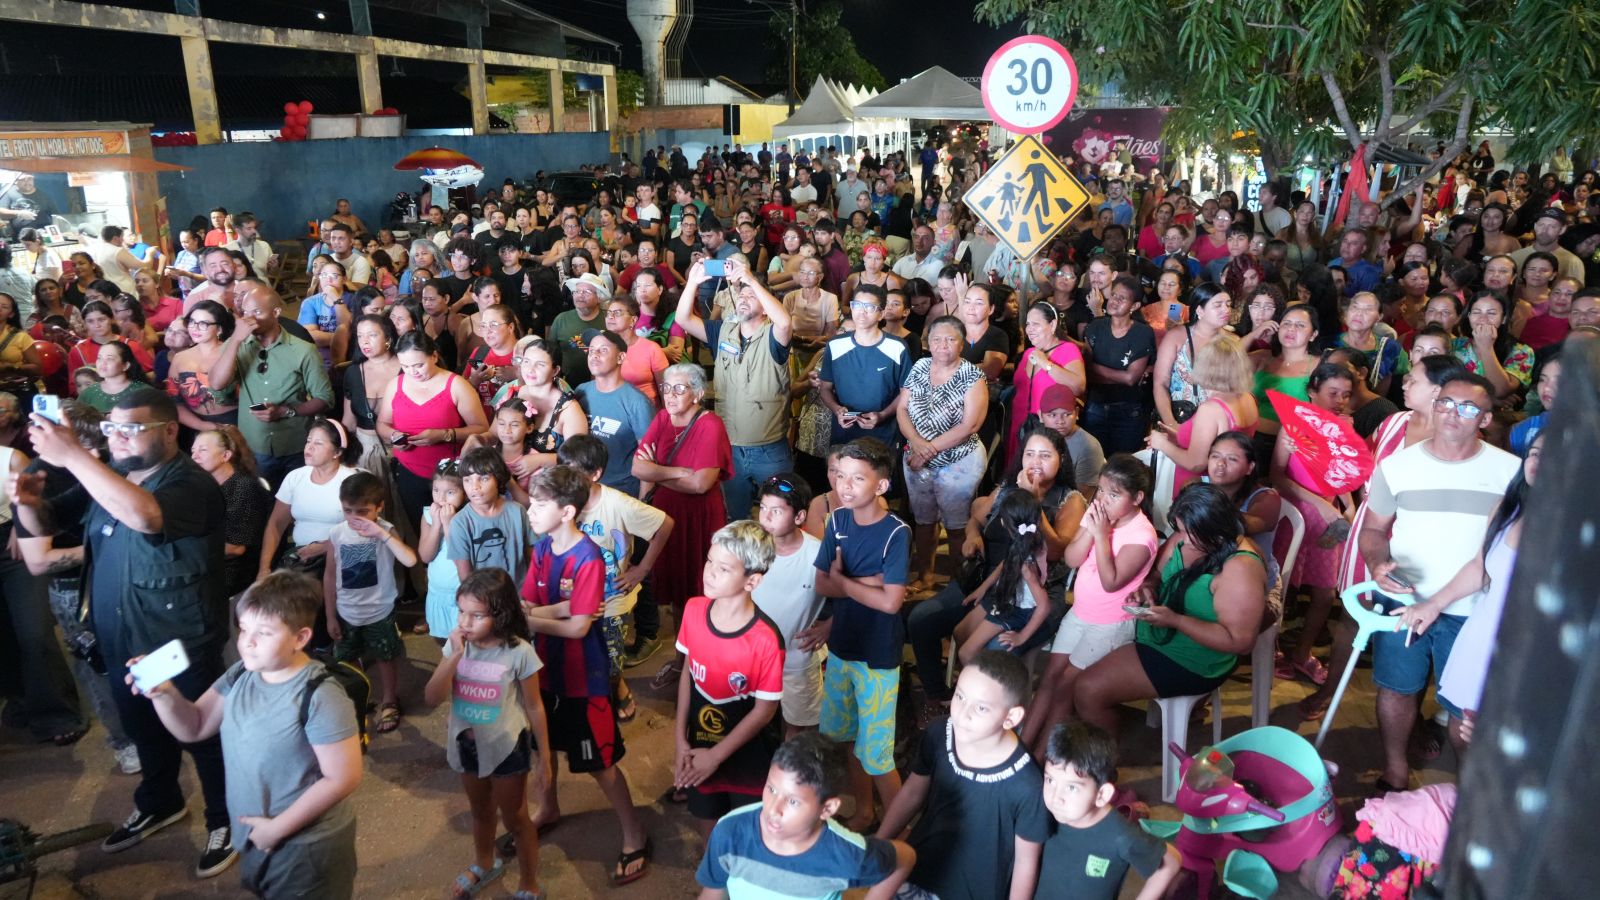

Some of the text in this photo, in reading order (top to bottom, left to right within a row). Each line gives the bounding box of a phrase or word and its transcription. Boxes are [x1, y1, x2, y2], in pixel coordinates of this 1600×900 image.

[1006, 57, 1053, 96] 30
[1016, 99, 1047, 112] km/h
[14, 139, 35, 157] FRITO
[36, 138, 47, 156] NA
[47, 138, 68, 155] HORA
[75, 138, 90, 154] HOT
[89, 137, 104, 154] DOG
[460, 684, 497, 699] WKND
[458, 703, 491, 720] LOVE
[975, 766, 1016, 783] ADVENTURE
